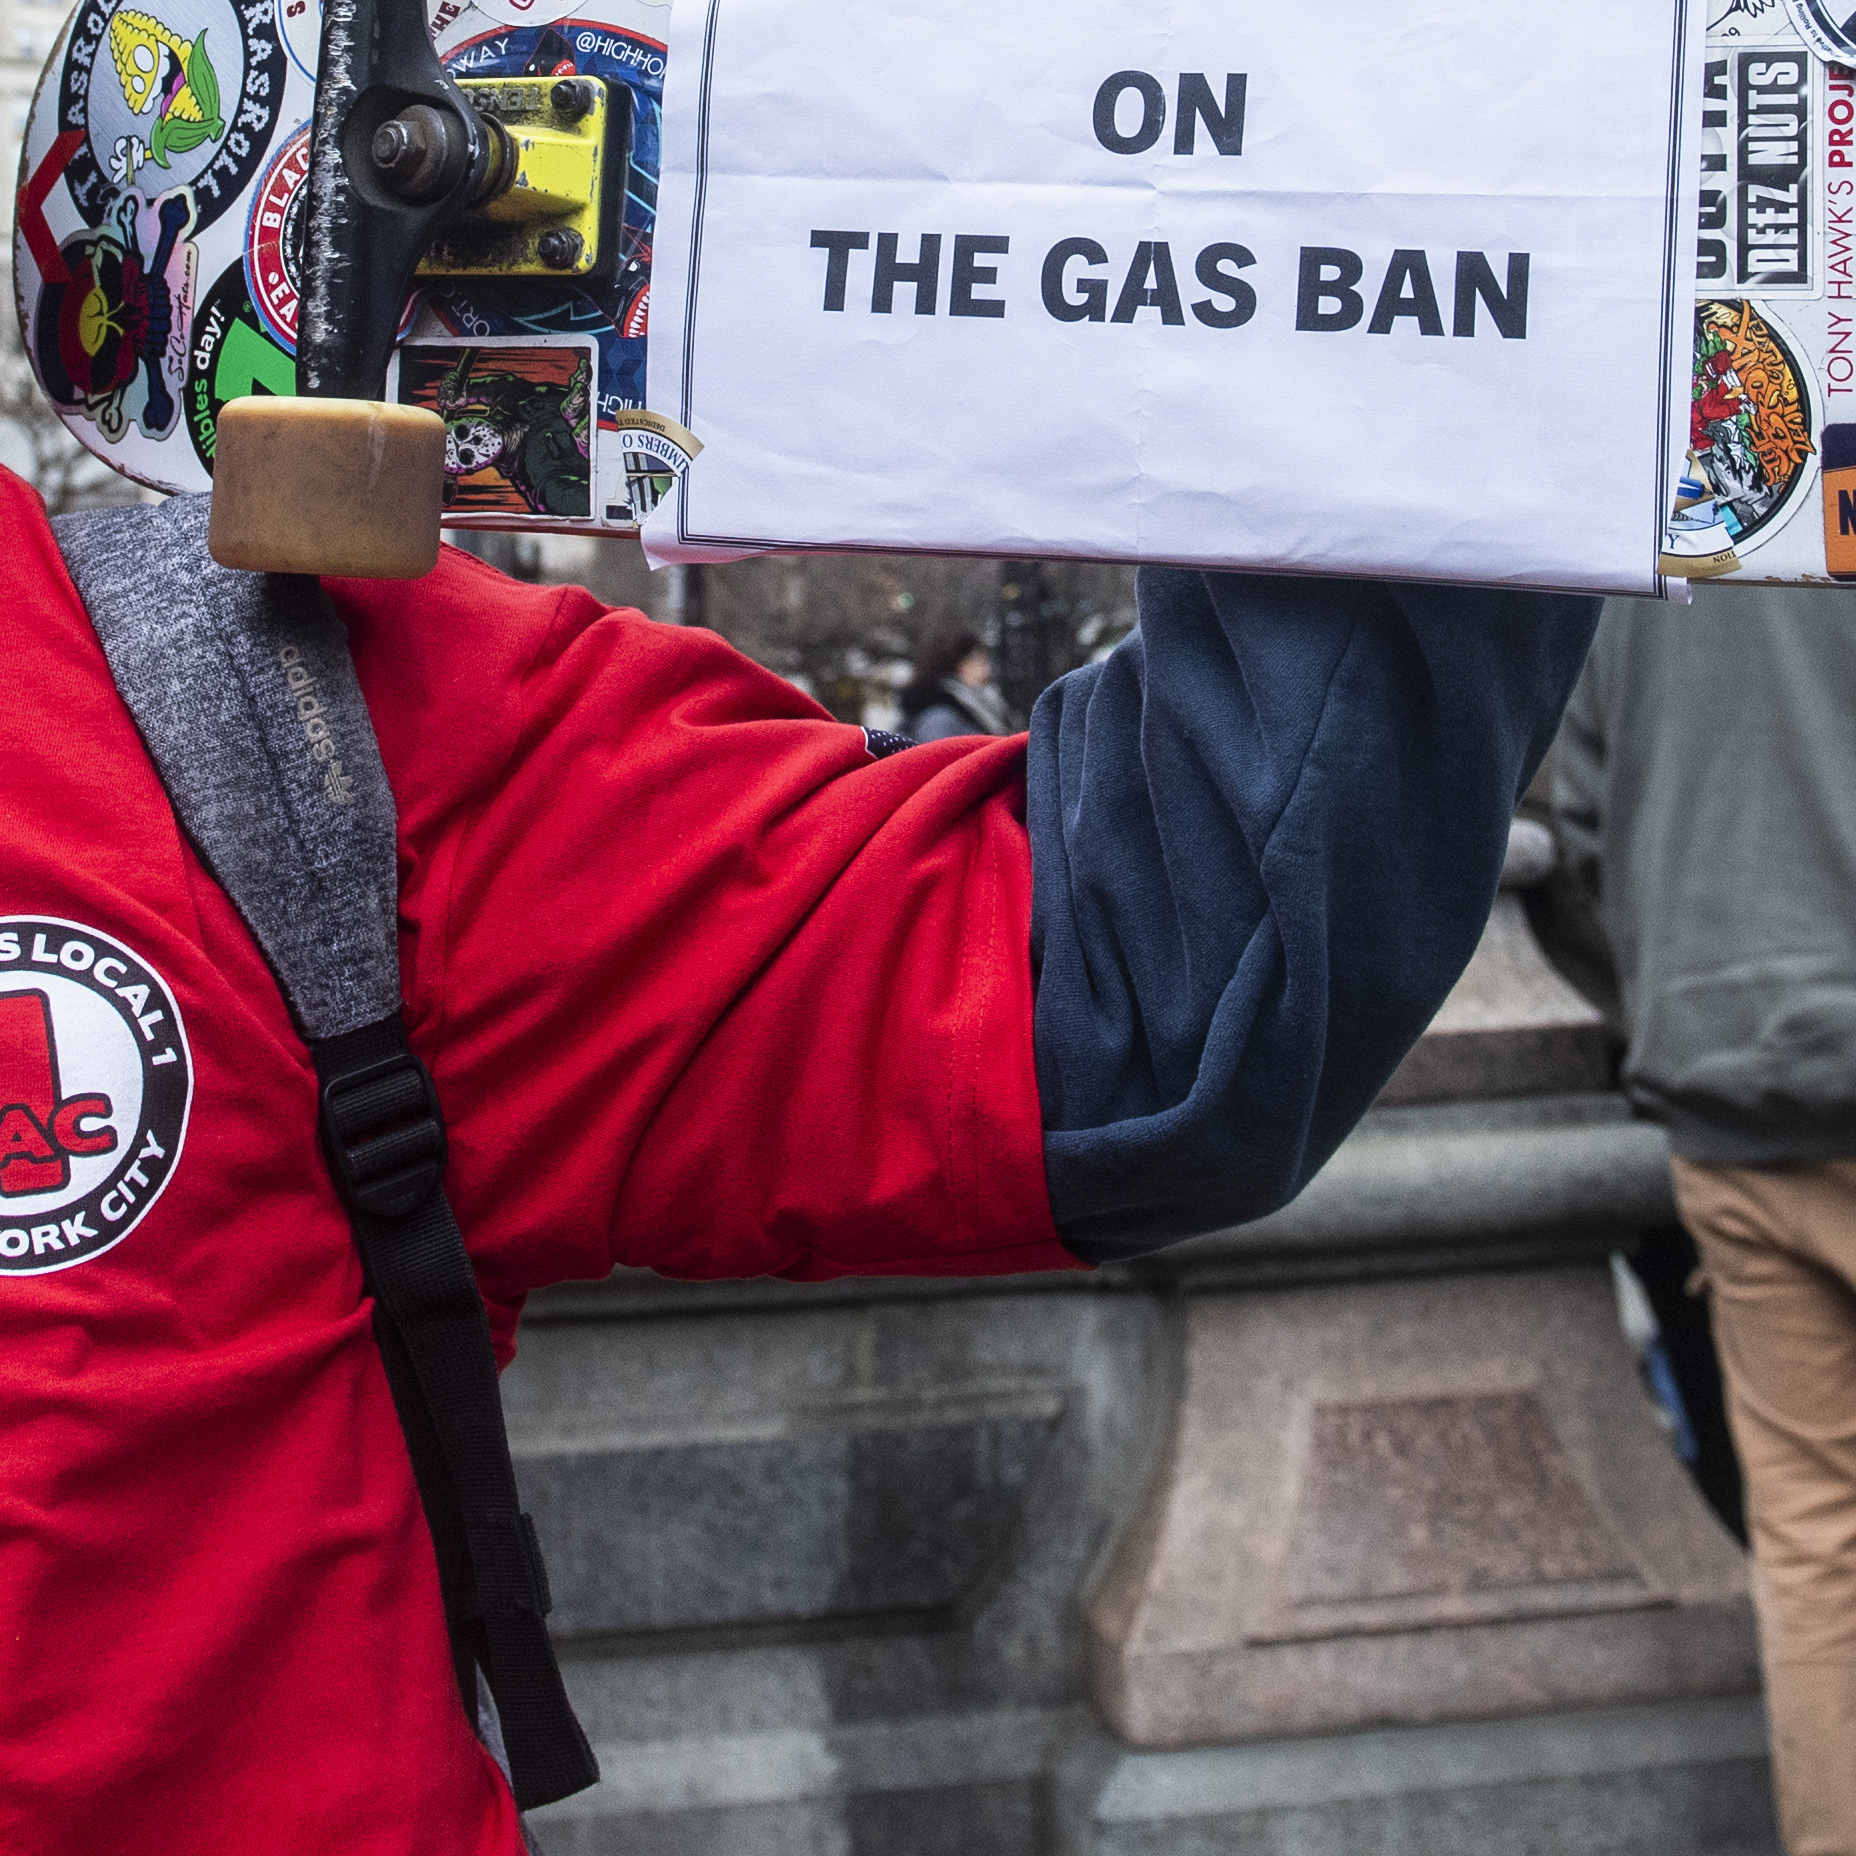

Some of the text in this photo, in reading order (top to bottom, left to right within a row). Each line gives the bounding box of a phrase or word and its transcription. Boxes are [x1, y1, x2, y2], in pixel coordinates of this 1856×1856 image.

[1092, 68, 1249, 157] ON
[1747, 60, 1800, 166] NUTS
[1747, 183, 1800, 274] DEEZ
[1827, 180, 1855, 299] HAWK'S
[808, 229, 1531, 341] THE GAS BAN
[1827, 311, 1855, 398] TONY
[629, 417, 666, 433] DEDICATED
[279, 645, 337, 763] adidas
[31, 932, 164, 1042] LOCAL
[151, 1046, 179, 1069] 1
[99, 1128, 167, 1223] CITY
